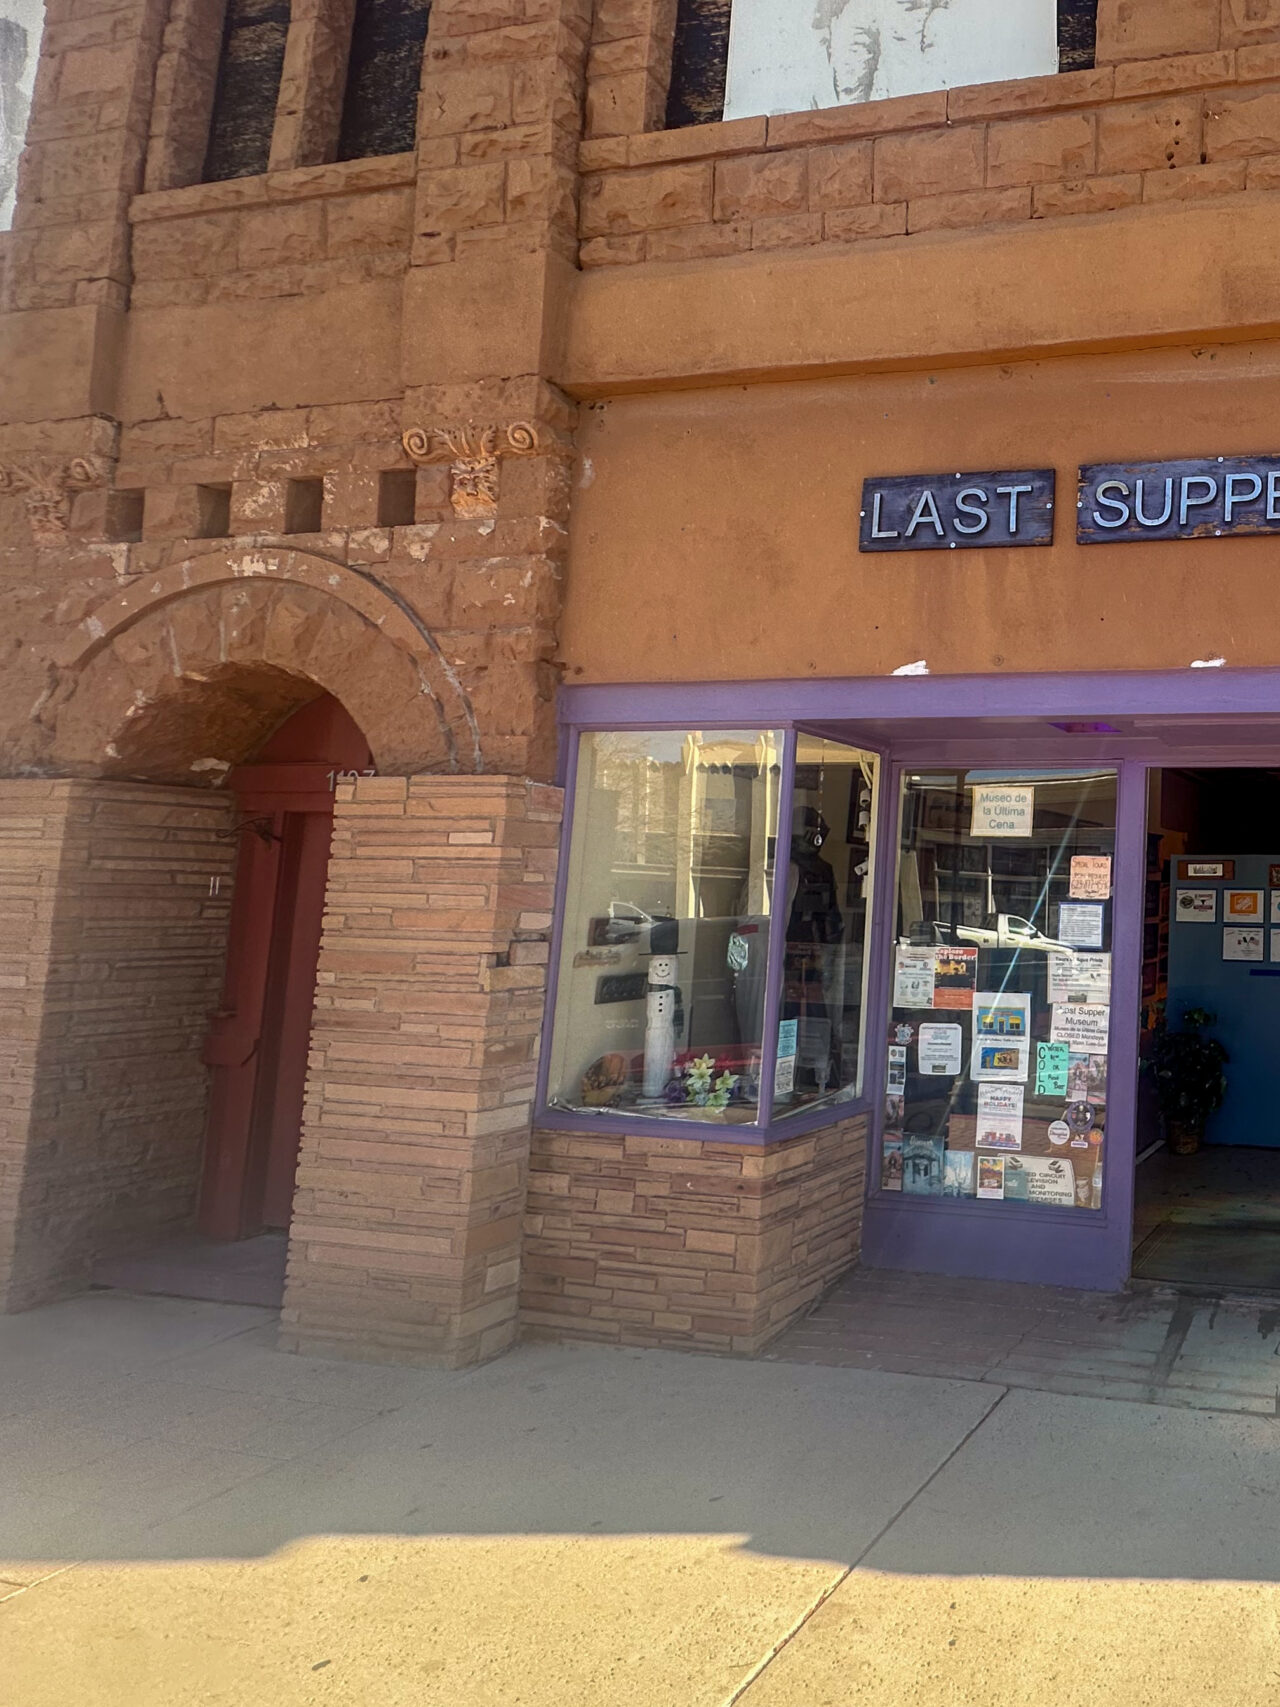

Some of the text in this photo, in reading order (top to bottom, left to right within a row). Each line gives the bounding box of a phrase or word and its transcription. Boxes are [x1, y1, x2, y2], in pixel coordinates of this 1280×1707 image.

[870, 484, 1033, 539] LAST
[980, 793, 1027, 803] Museo de
[983, 804, 1026, 817] la Última
[988, 819, 1016, 830] Cena
[1078, 1006, 1106, 1018] Supper
[1065, 1016, 1098, 1027] Museum
[1056, 1031, 1080, 1039] CLOSED
